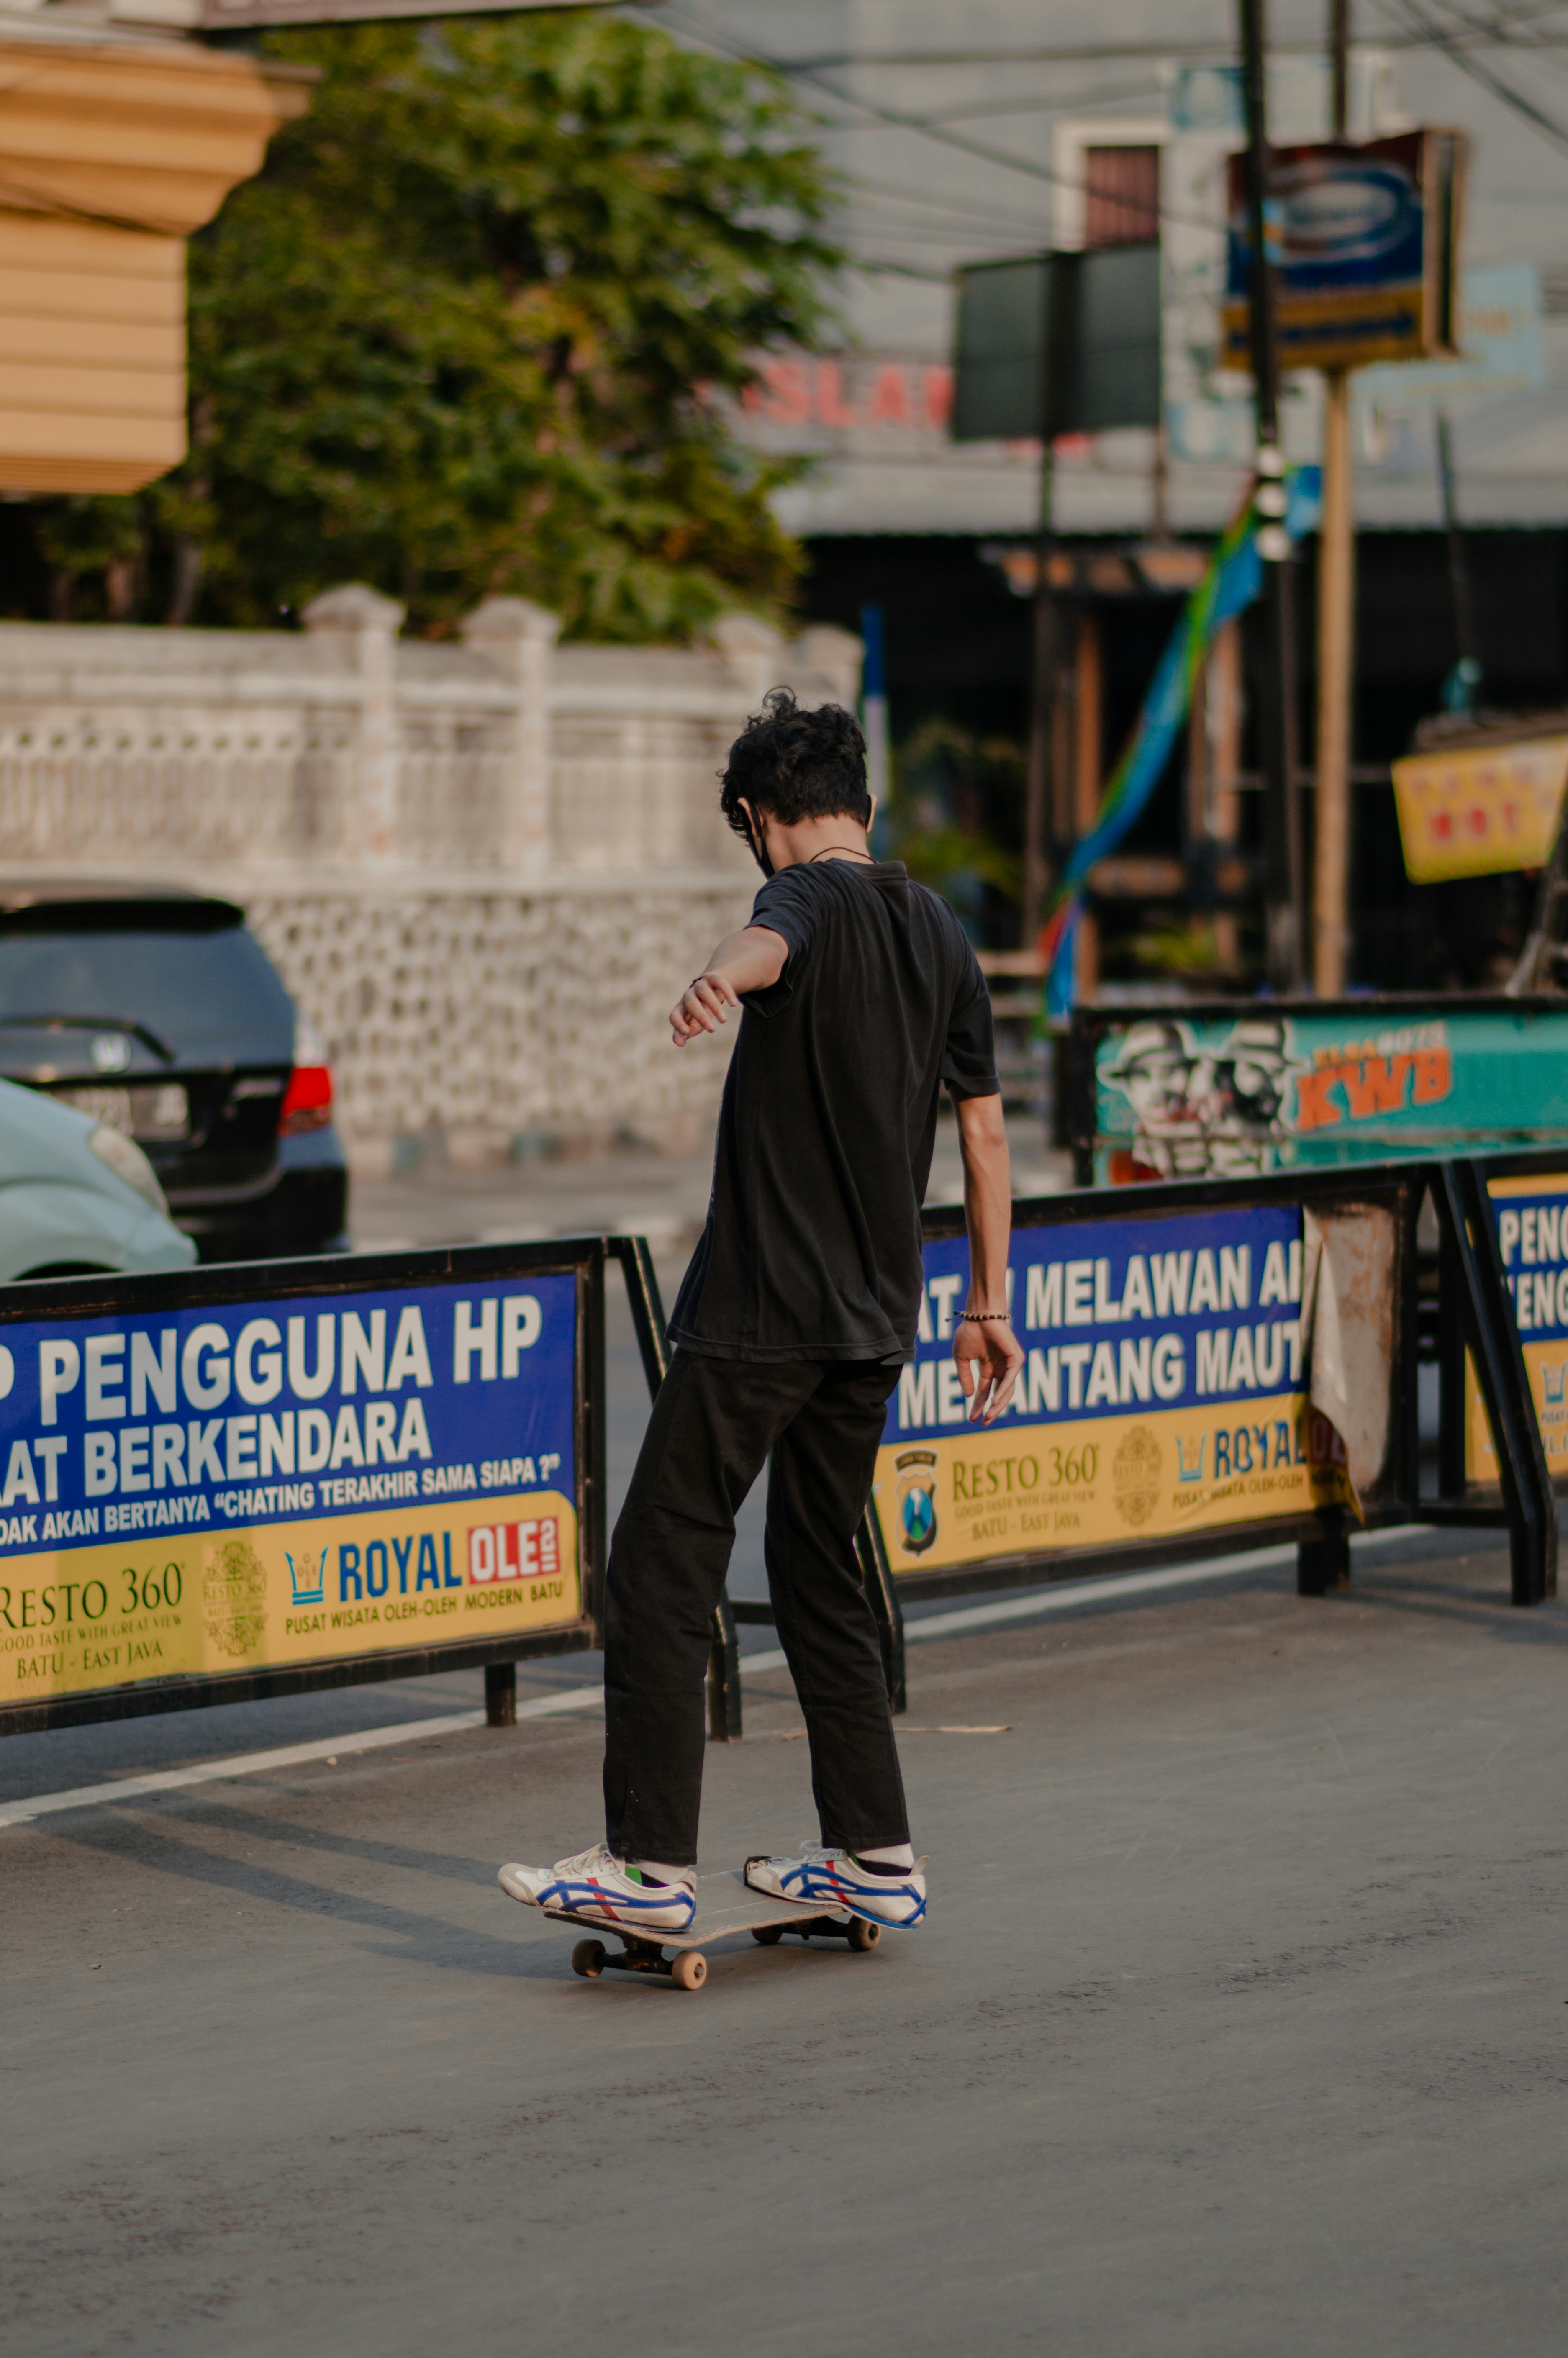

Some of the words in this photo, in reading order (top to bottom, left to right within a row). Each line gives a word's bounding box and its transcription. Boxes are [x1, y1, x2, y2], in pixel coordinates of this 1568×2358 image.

[1296, 1047, 1450, 1131] KWB
[1026, 1243, 1251, 1331] MELAWAN
[40, 1306, 434, 1425] PENGGUNA
[453, 1294, 542, 1383] HP
[1196, 1319, 1301, 1396] MAUT
[0, 1435, 67, 1507] AT
[84, 1397, 433, 1497] BERKENDARA
[1214, 1418, 1307, 1479] ROYAL
[42, 1508, 99, 1541] AKAN
[105, 1495, 210, 1532] BERTANYA
[319, 1471, 418, 1506] TERAKHIR
[422, 1462, 477, 1495] SAMA
[480, 1456, 536, 1488] SIAPA
[953, 1455, 1039, 1501] RESTO
[1249, 1474, 1303, 1495] OLEH-OLEH
[973, 1516, 1007, 1541] BATU
[1021, 1512, 1050, 1532] EAST
[1054, 1510, 1080, 1533] JAVA
[203, 1584, 241, 1601] RESTO
[339, 1530, 462, 1602] ROYAL
[0, 1581, 107, 1629] RESTO
[39, 1629, 73, 1647] TASTE
[78, 1625, 107, 1641] WITH
[112, 1618, 148, 1637] GREAT
[153, 1614, 182, 1628] VIEW
[286, 1612, 326, 1634] PUSAT
[331, 1604, 379, 1629] WISATA
[384, 1596, 457, 1622] OLEH-OLEH
[464, 1587, 522, 1610] MODERN
[531, 1580, 562, 1602] BATU
[17, 1652, 63, 1679] BATU
[84, 1646, 121, 1670] EAST
[128, 1640, 163, 1667] JAVA
